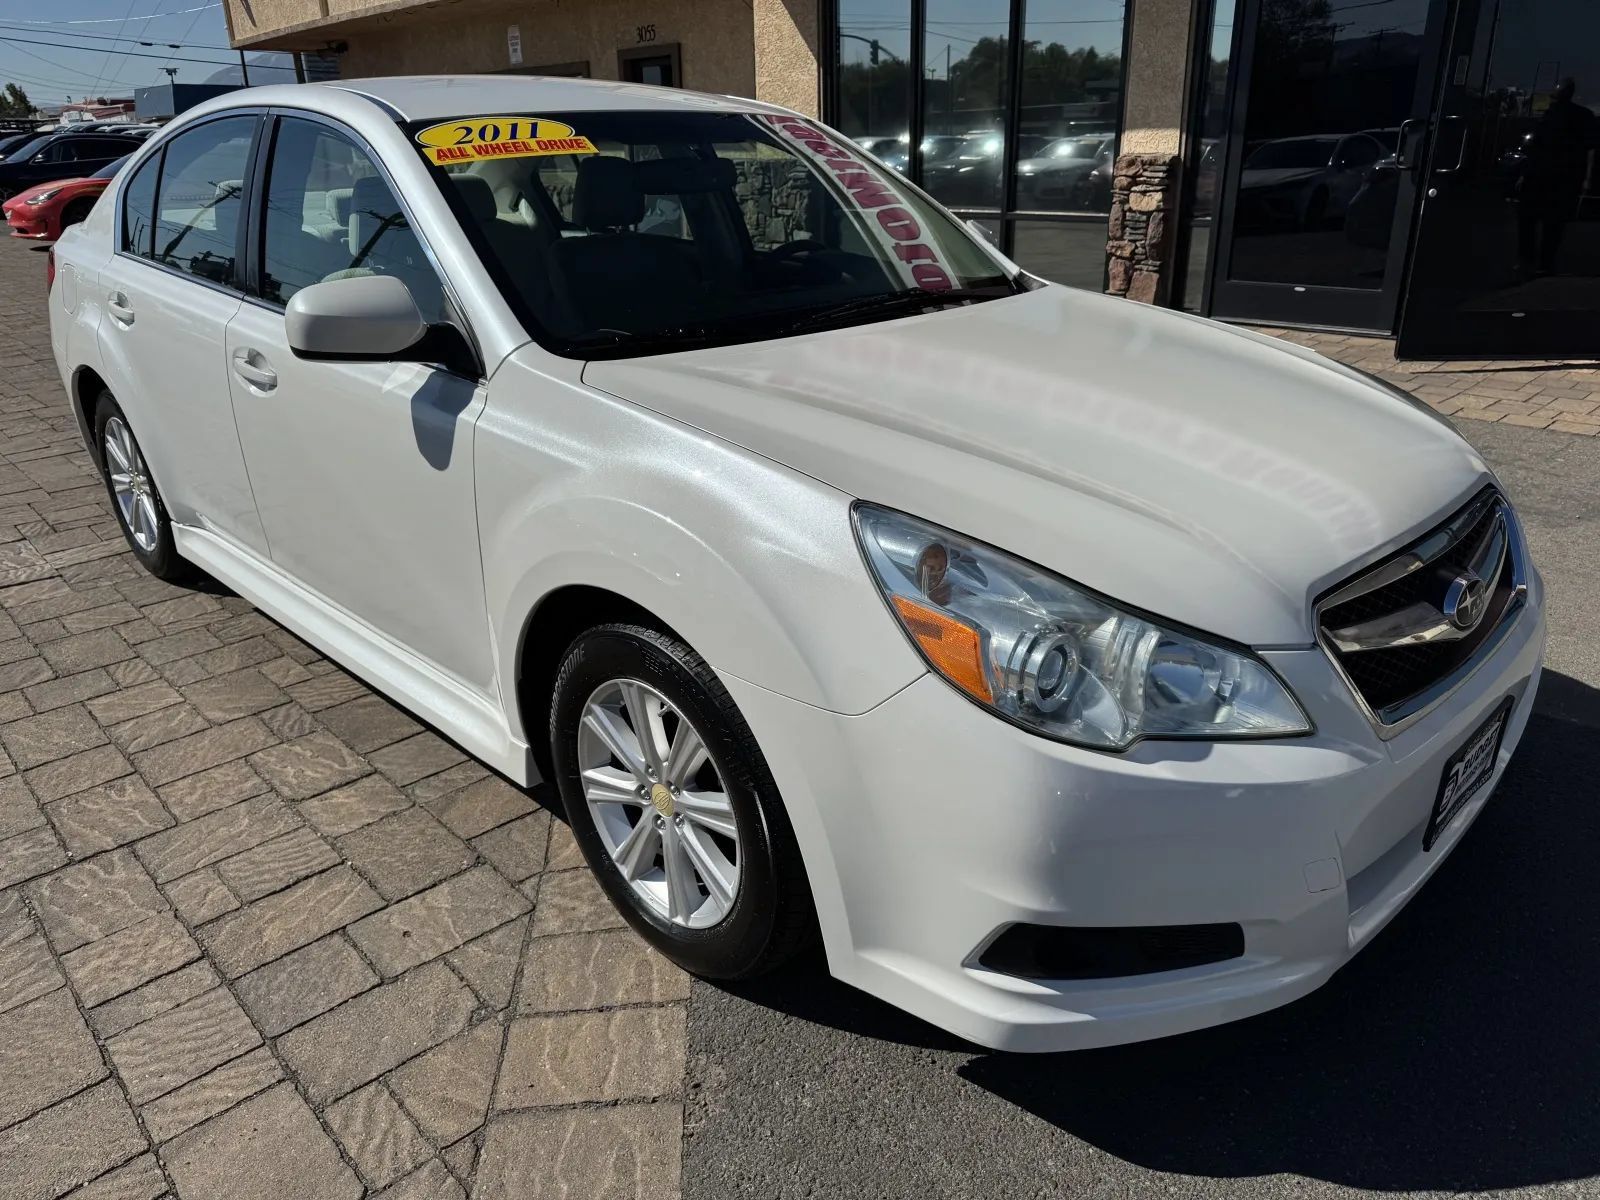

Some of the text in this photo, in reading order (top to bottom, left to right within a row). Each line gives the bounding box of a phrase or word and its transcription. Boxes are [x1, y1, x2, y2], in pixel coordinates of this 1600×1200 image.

[636, 24, 656, 44] 3055
[453, 122, 542, 145] 2011
[436, 138, 588, 161] ALL WHEEL DRIVE
[1463, 725, 1500, 774] BUDGET
